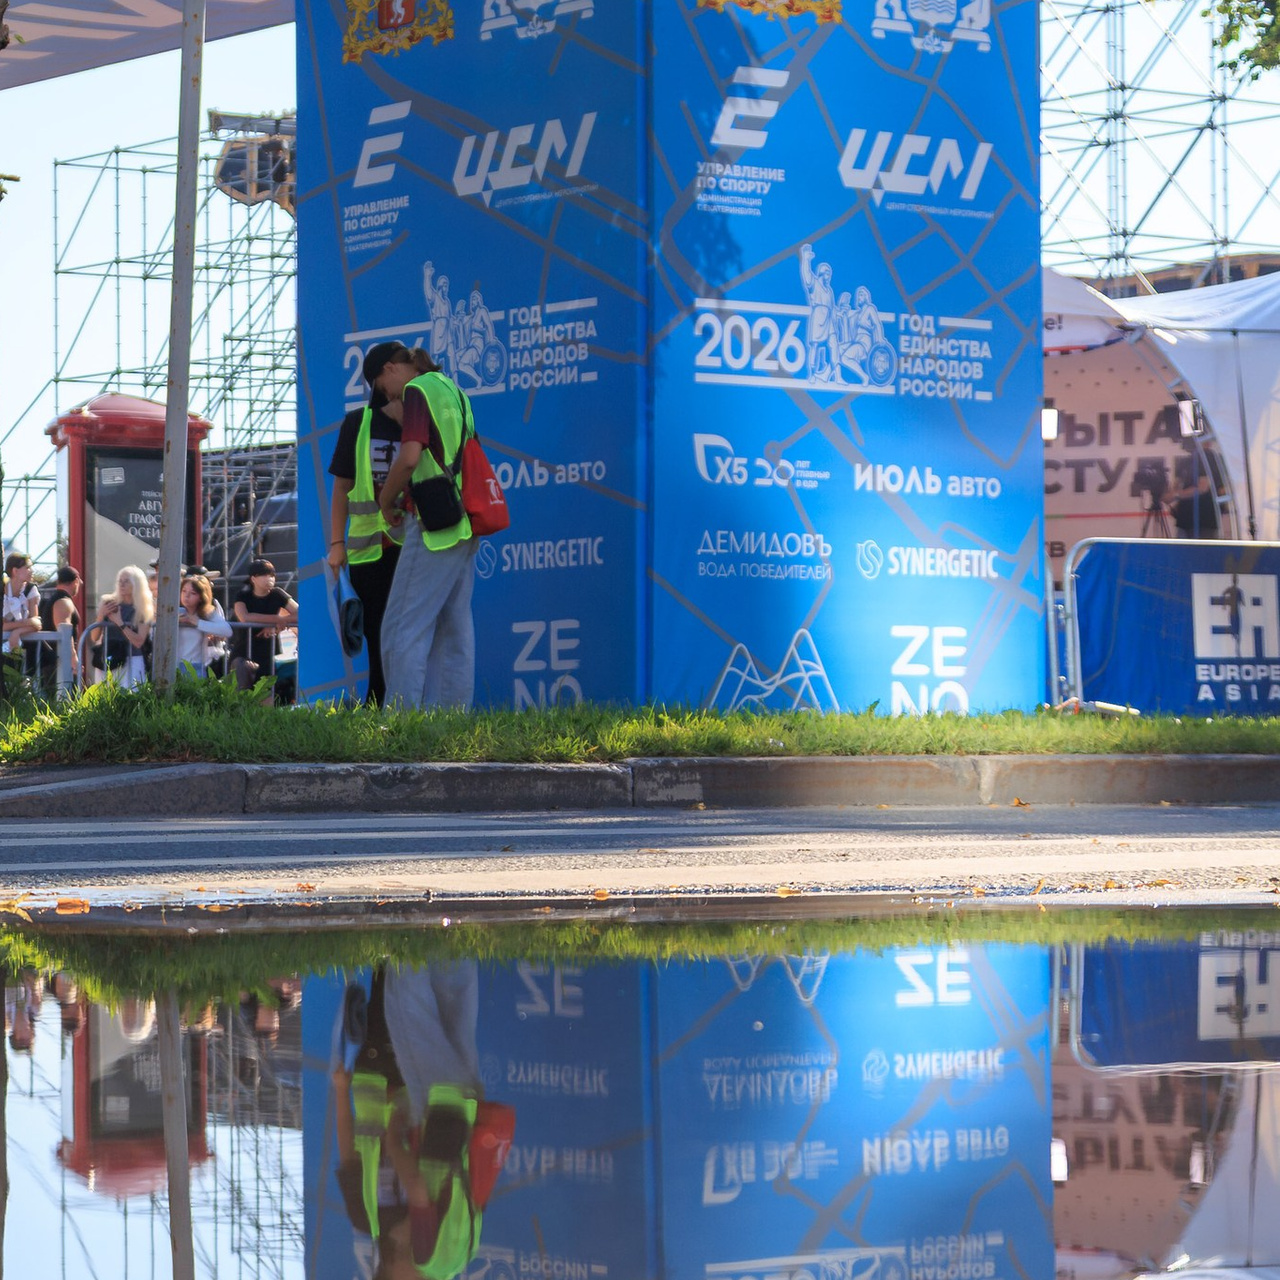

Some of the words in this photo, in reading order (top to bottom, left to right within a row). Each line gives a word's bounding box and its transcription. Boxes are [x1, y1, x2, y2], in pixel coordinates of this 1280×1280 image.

[696, 161, 786, 182] УПРАВЛЕНИЕ
[697, 176, 717, 189] ПО
[719, 177, 771, 195] СПОРТУ
[344, 195, 409, 218] УПРАВЛЕНИЕ
[344, 218, 358, 231] ПО
[360, 211, 399, 228] СПОРТУ
[509, 306, 542, 326] ГОД
[899, 313, 935, 335] ГОД
[509, 320, 597, 348] ЕДИНСТВА
[694, 312, 806, 373] 2026
[510, 344, 589, 369] НАРОДОВ
[899, 336, 992, 359] ЕДИНСТВА
[510, 367, 578, 391] РОССИИ
[899, 357, 984, 380] НАРОДОВ
[899, 378, 973, 400] РОССИИ
[555, 461, 606, 484] авто
[796, 460, 811, 469] лет
[796, 470, 830, 479] главные
[797, 478, 803, 487] в
[805, 479, 819, 488] еде
[854, 463, 942, 496] ИЮЛЬ
[947, 475, 1001, 498] авто
[129, 512, 161, 525] ГРАФС
[128, 525, 160, 538] ОСЕЙ
[502, 537, 604, 572] SYNERGETIC
[696, 529, 832, 558] ДЕМИДОВЪ
[698, 561, 737, 577] ВОДА
[740, 562, 832, 580] ПОБЕДИТЕЛЕЙ
[888, 545, 999, 579] SYNERGETIC
[512, 619, 580, 671] ZE
[890, 625, 967, 677] ZE
[1195, 664, 1280, 681] EUROPE
[1197, 684, 1280, 702] ASIA
